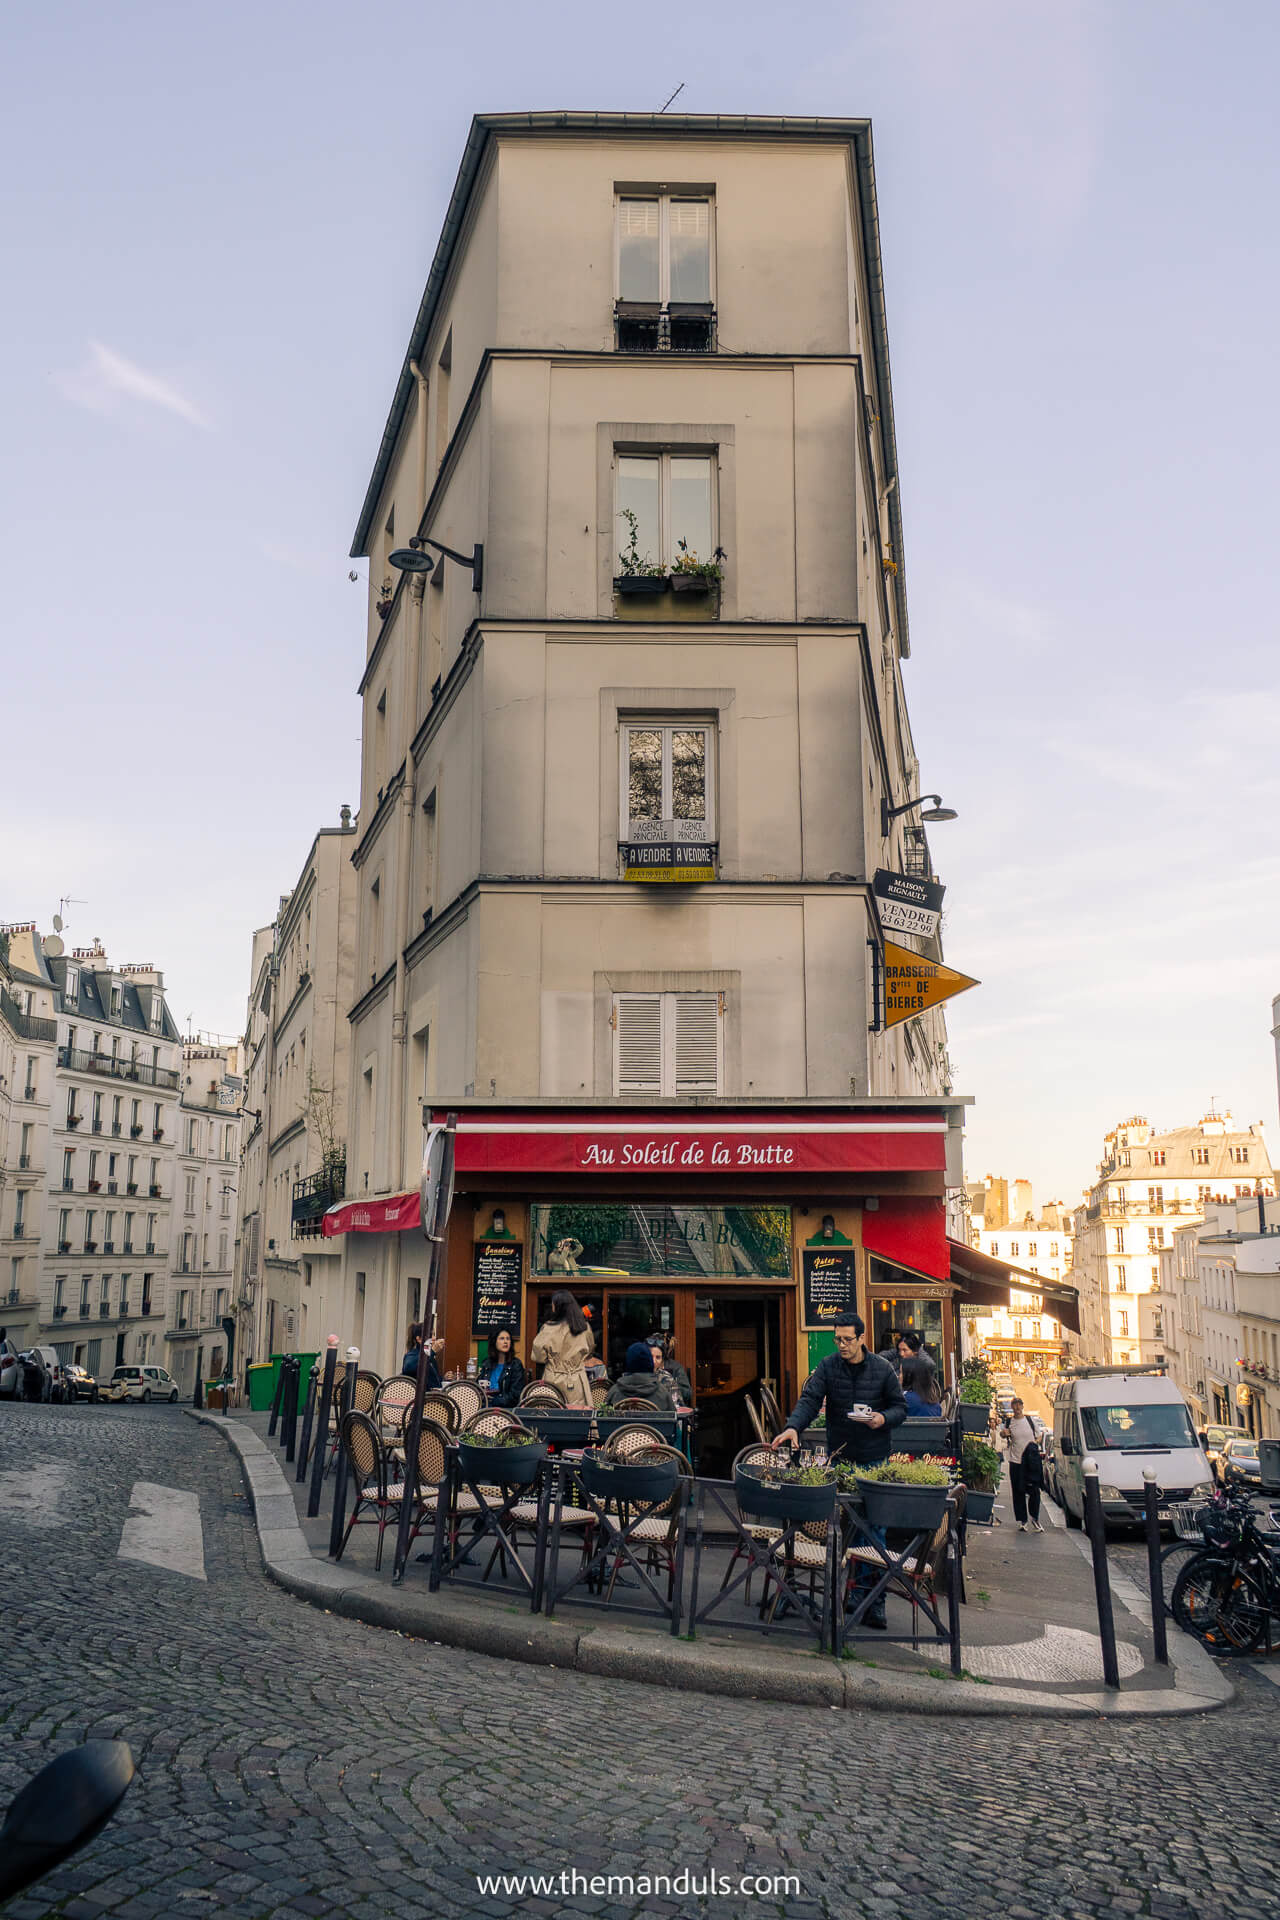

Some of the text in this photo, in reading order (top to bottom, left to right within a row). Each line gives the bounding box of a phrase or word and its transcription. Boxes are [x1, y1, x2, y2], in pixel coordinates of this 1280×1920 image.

[638, 821, 664, 832] AGENCE
[680, 821, 703, 832] AGENCE
[633, 831, 668, 841] PRINCIPALE
[678, 831, 707, 841] PRINCIPALE
[630, 847, 672, 863] A VENDRE
[676, 847, 711, 863] A VENDRE
[887, 885, 928, 901] RIGNAULT
[894, 879, 925, 893] MAISON
[882, 902, 935, 925] VENDRE
[881, 913, 932, 933] 63 63 22 99
[886, 966, 938, 978] BRASSERIE
[916, 981, 929, 993] DE
[887, 996, 924, 1009] BIERES
[581, 1141, 794, 1165] Au Soleil de la Butte
[683, 1219, 708, 1242] LA
